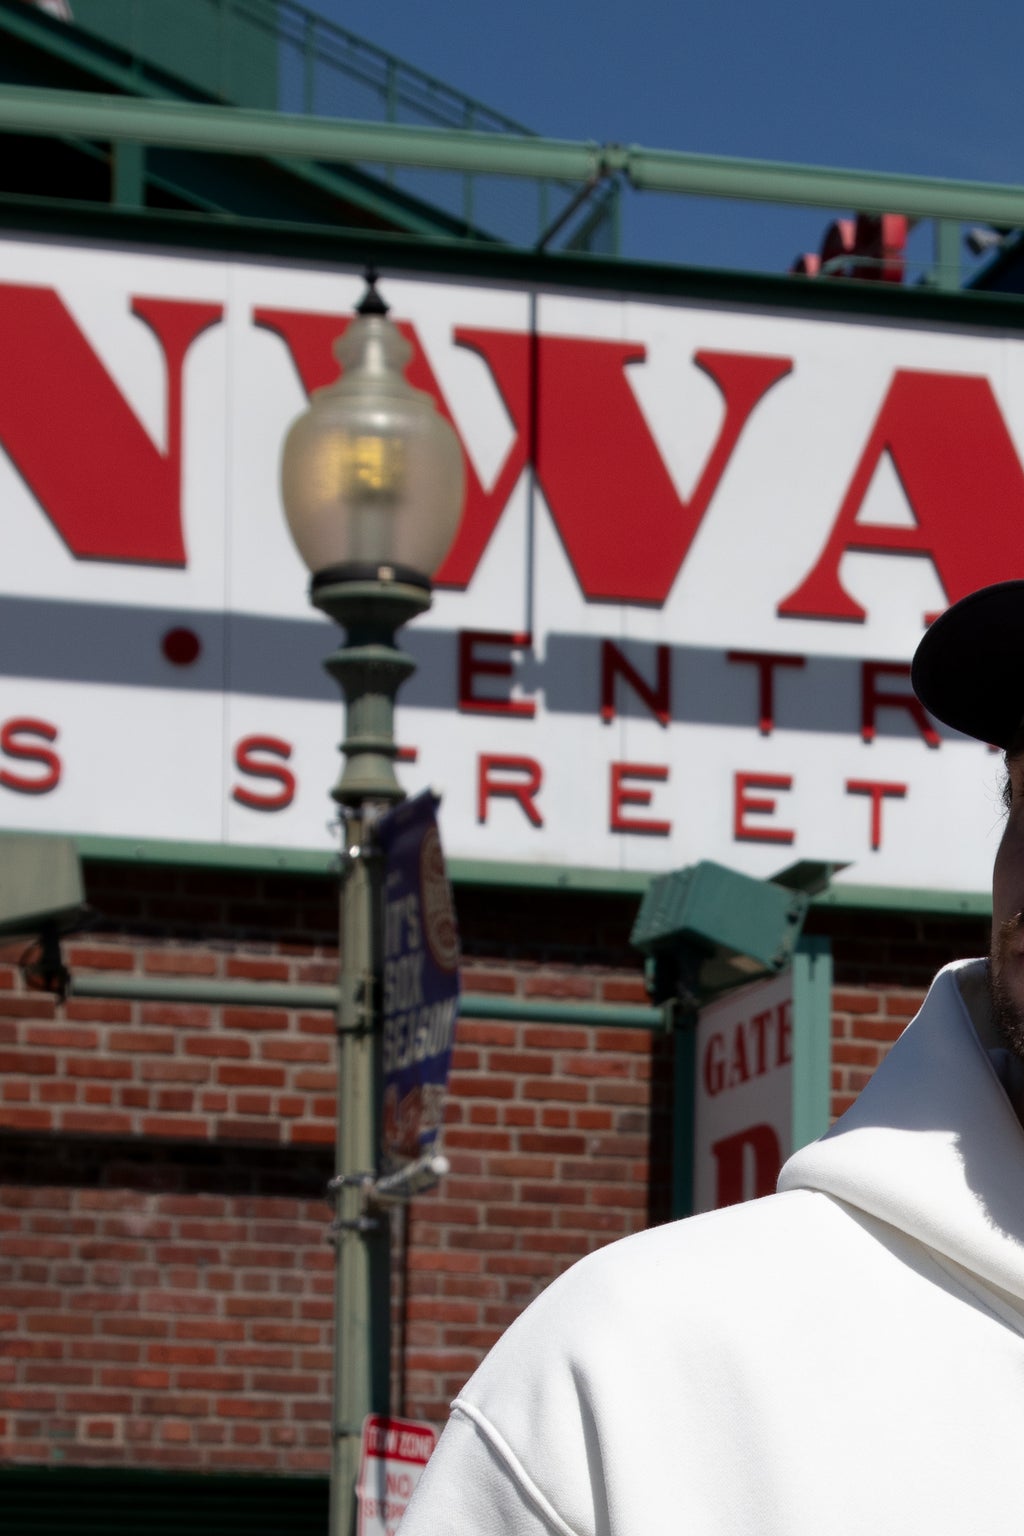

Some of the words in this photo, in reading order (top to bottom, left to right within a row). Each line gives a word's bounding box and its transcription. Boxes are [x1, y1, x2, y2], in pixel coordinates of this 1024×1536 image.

[0, 717, 62, 795] S
[232, 734, 909, 852] SREET
[703, 999, 793, 1099] GATE
[386, 1474, 413, 1498] NO
